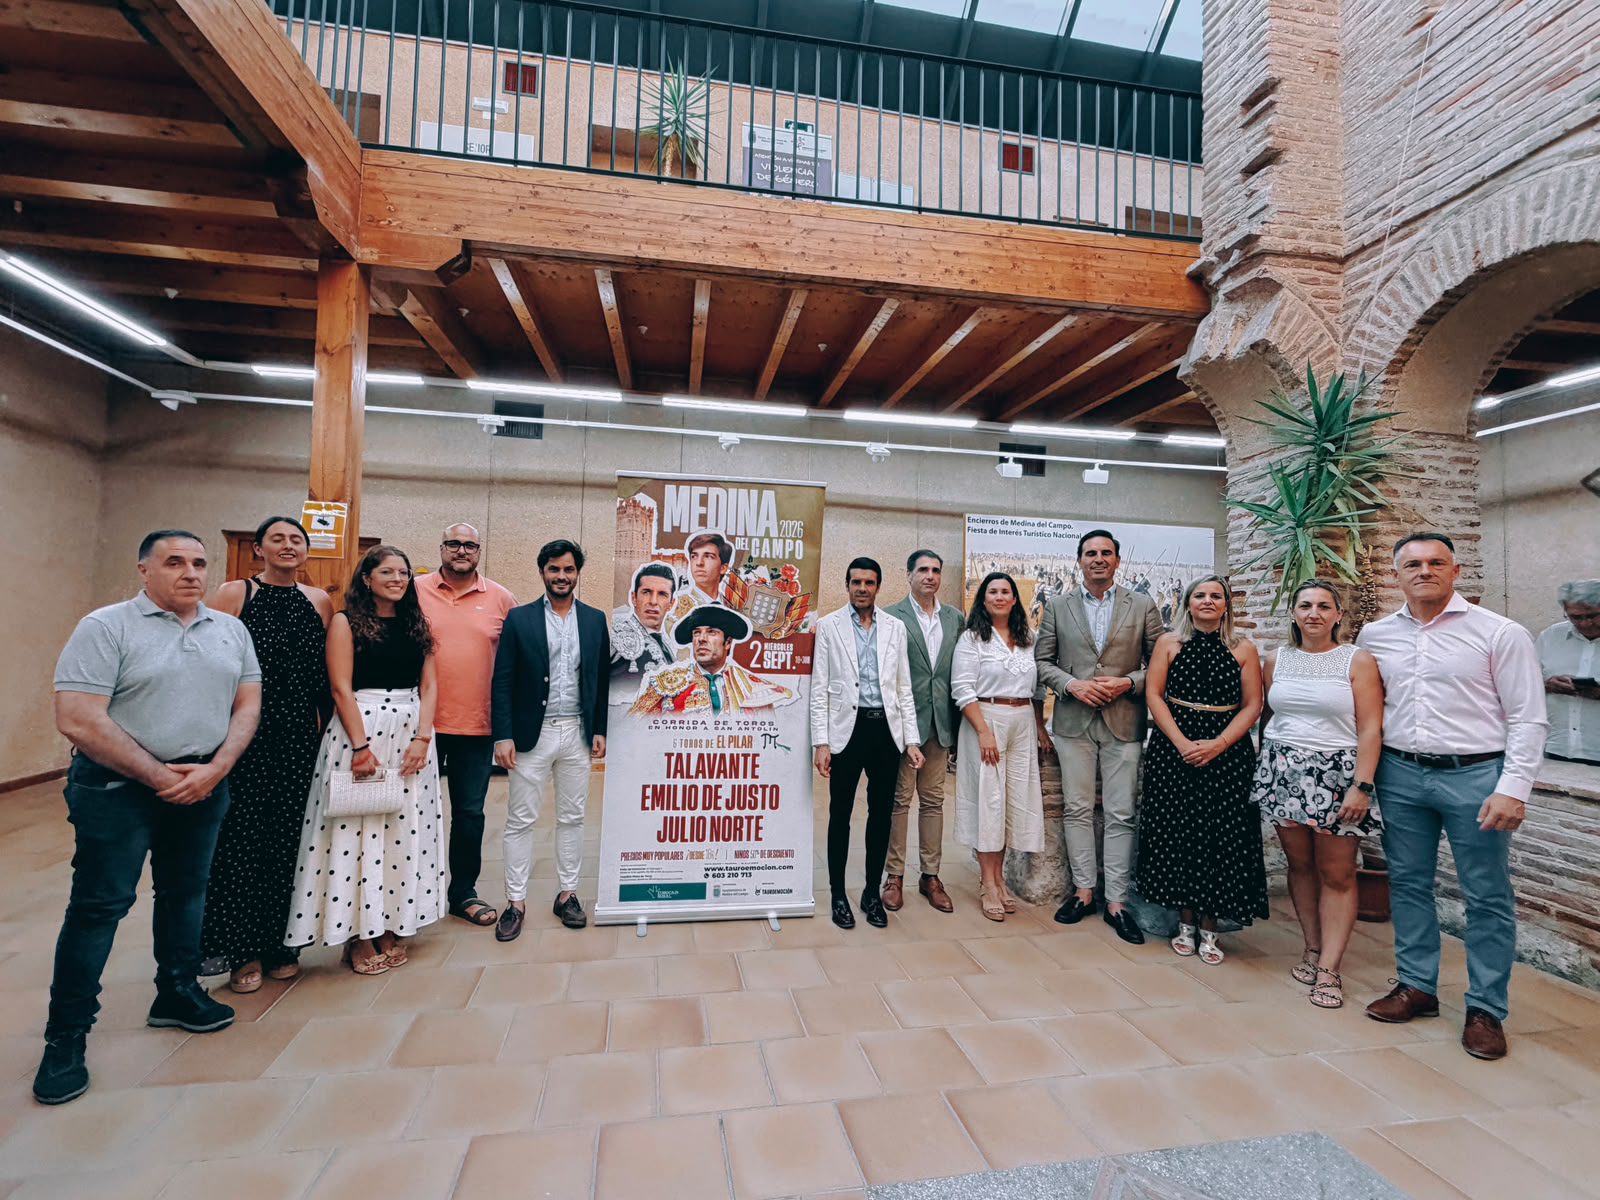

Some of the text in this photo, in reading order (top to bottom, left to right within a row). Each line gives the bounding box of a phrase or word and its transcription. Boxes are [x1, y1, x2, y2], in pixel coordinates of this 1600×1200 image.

[756, 172, 771, 181] DE
[663, 484, 804, 538] MEDINA 2026
[967, 516, 999, 525] Encierros
[1000, 518, 1009, 526] de
[1010, 519, 1036, 527] Medina
[1048, 522, 1074, 531] Campo.
[967, 526, 988, 534] Fiesta
[988, 527, 998, 535] de
[999, 528, 1023, 536] Interés
[1023, 530, 1052, 538] Turístico
[735, 537, 804, 560] DEL CAMPO
[749, 640, 762, 668] 2
[763, 650, 797, 670] SEPT.
[679, 738, 703, 749] TOROS
[705, 738, 714, 749] DE
[716, 735, 726, 749] EL
[727, 735, 754, 749] PILAR
[664, 752, 760, 779] TALAVANTE
[641, 784, 780, 811] EMILIO DE JUSTO
[656, 815, 764, 843] JULIO NORTE
[620, 851, 643, 861] PRECIOS
[642, 851, 655, 861] MUY
[654, 851, 684, 861] POPULARES
[760, 849, 767, 859] DE
[767, 849, 795, 859] DESCUENTO
[703, 864, 794, 872] www.tauroemocion.com
